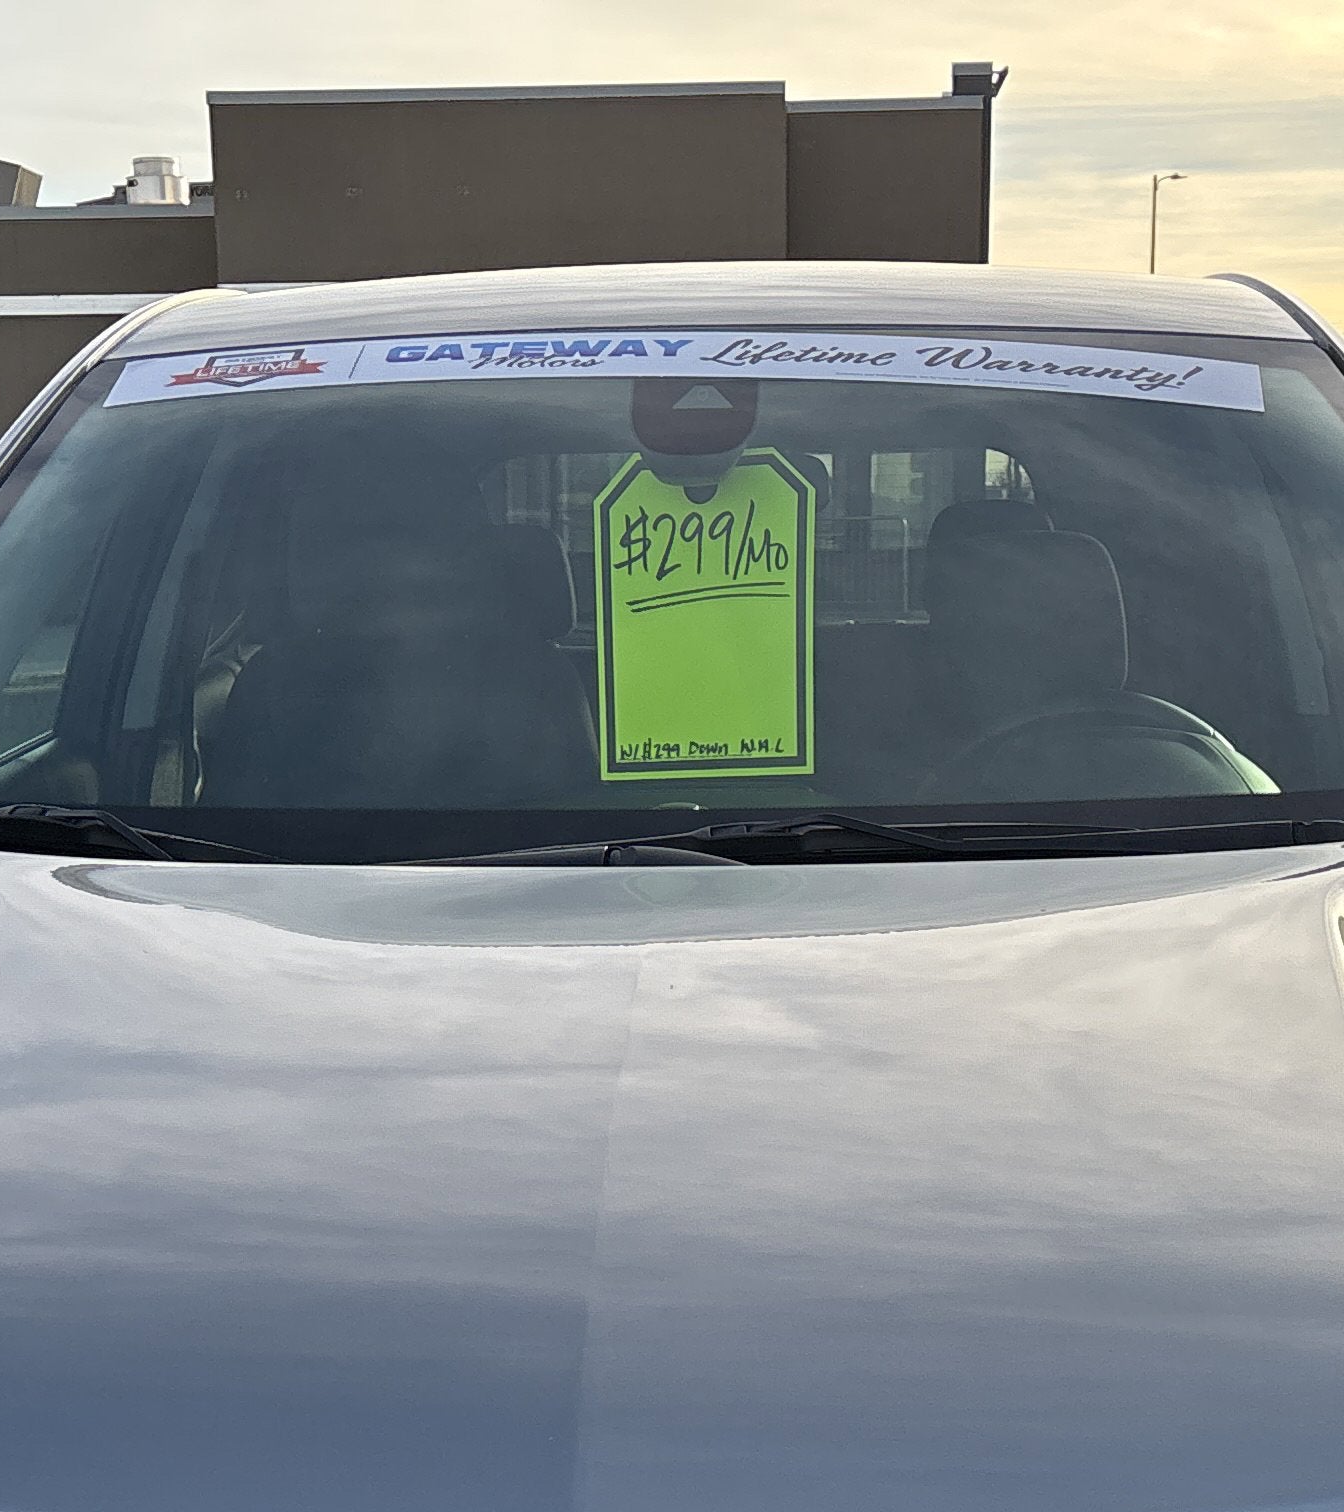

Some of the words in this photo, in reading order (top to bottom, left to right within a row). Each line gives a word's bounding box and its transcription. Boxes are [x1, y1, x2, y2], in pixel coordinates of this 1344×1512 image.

[385, 339, 694, 363] GATEWAY
[468, 353, 605, 370] Motors
[196, 360, 301, 378] LIFETIME
[700, 338, 897, 366] Lifetime
[916, 346, 1202, 391] Warranty!
